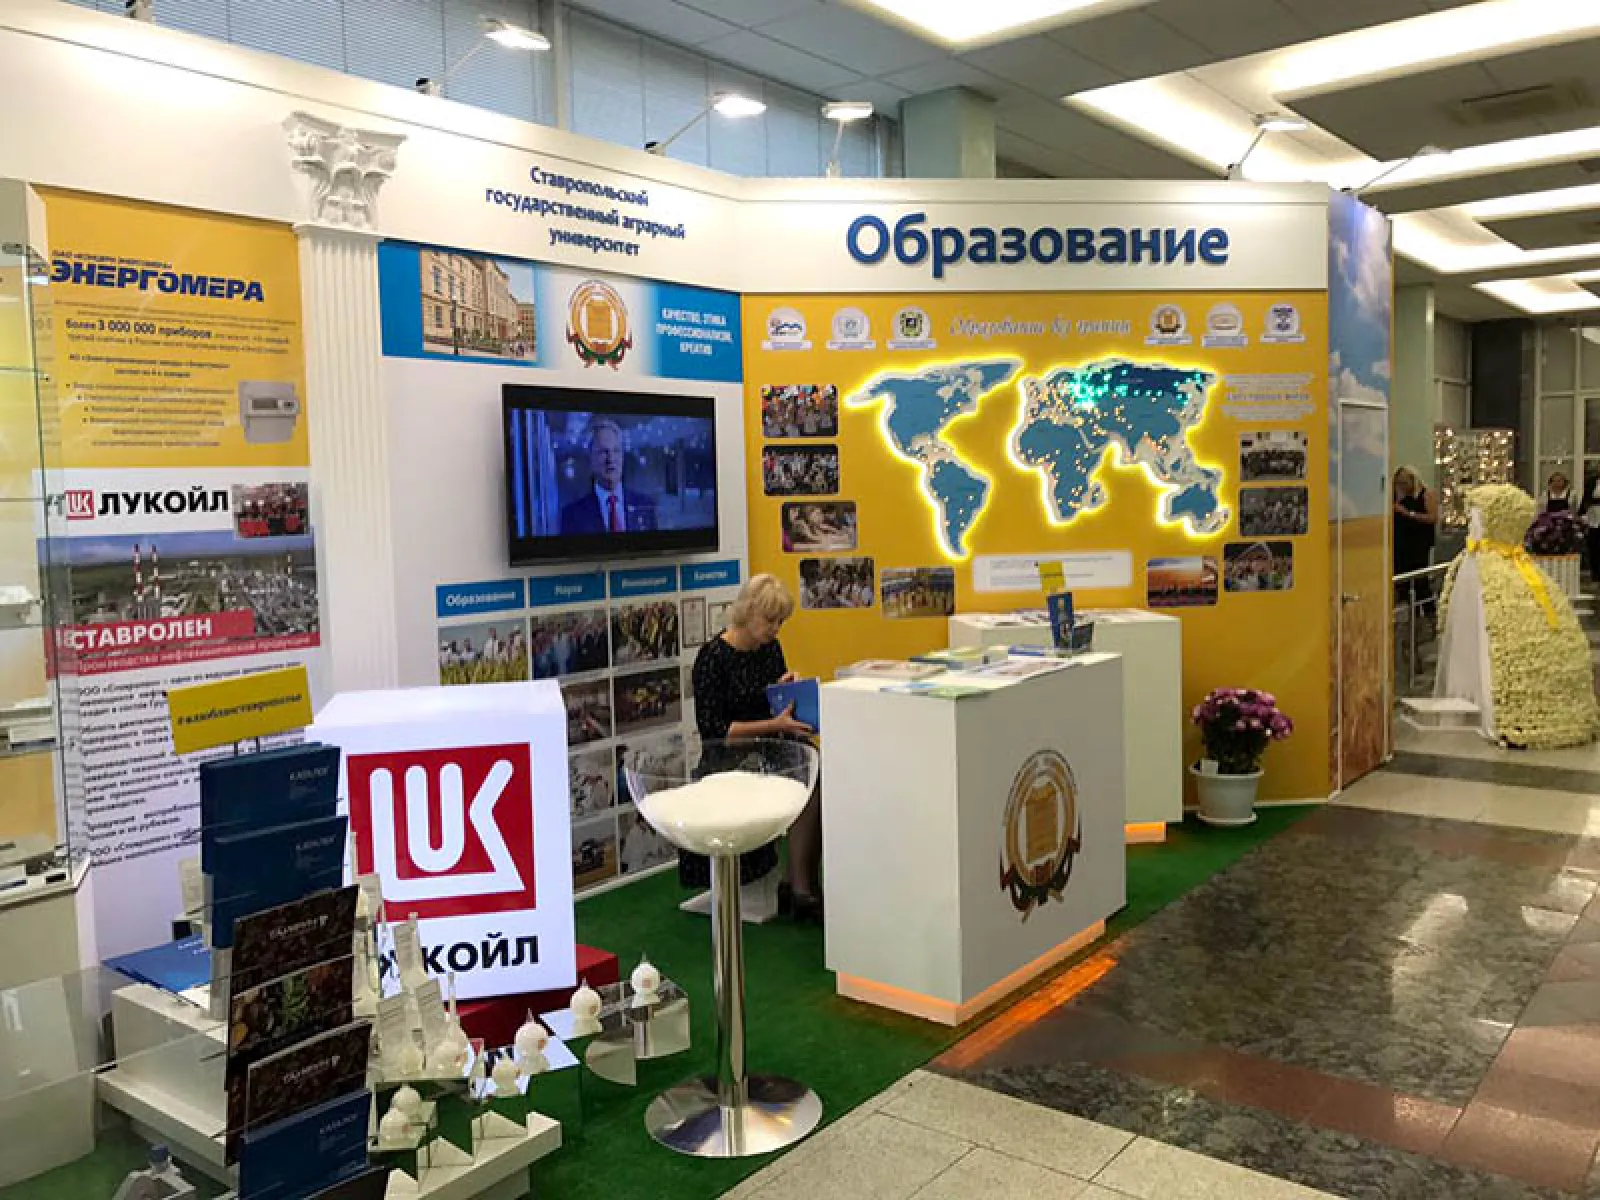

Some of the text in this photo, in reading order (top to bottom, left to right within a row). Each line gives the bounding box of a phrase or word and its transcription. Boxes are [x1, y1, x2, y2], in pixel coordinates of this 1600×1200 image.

[530, 165, 649, 207] Ставропольский
[485, 187, 686, 240] государственный аграрный
[548, 227, 641, 257] университет
[846, 211, 1230, 280] Образование
[51, 258, 265, 303] ЭНЕРГОМЕРА
[108, 319, 131, 333] 000
[133, 321, 156, 335] 000
[98, 486, 230, 515] ЛУКОЙЛ
[446, 590, 517, 607] Образование
[70, 618, 213, 650] СТАВРОЛЕН
